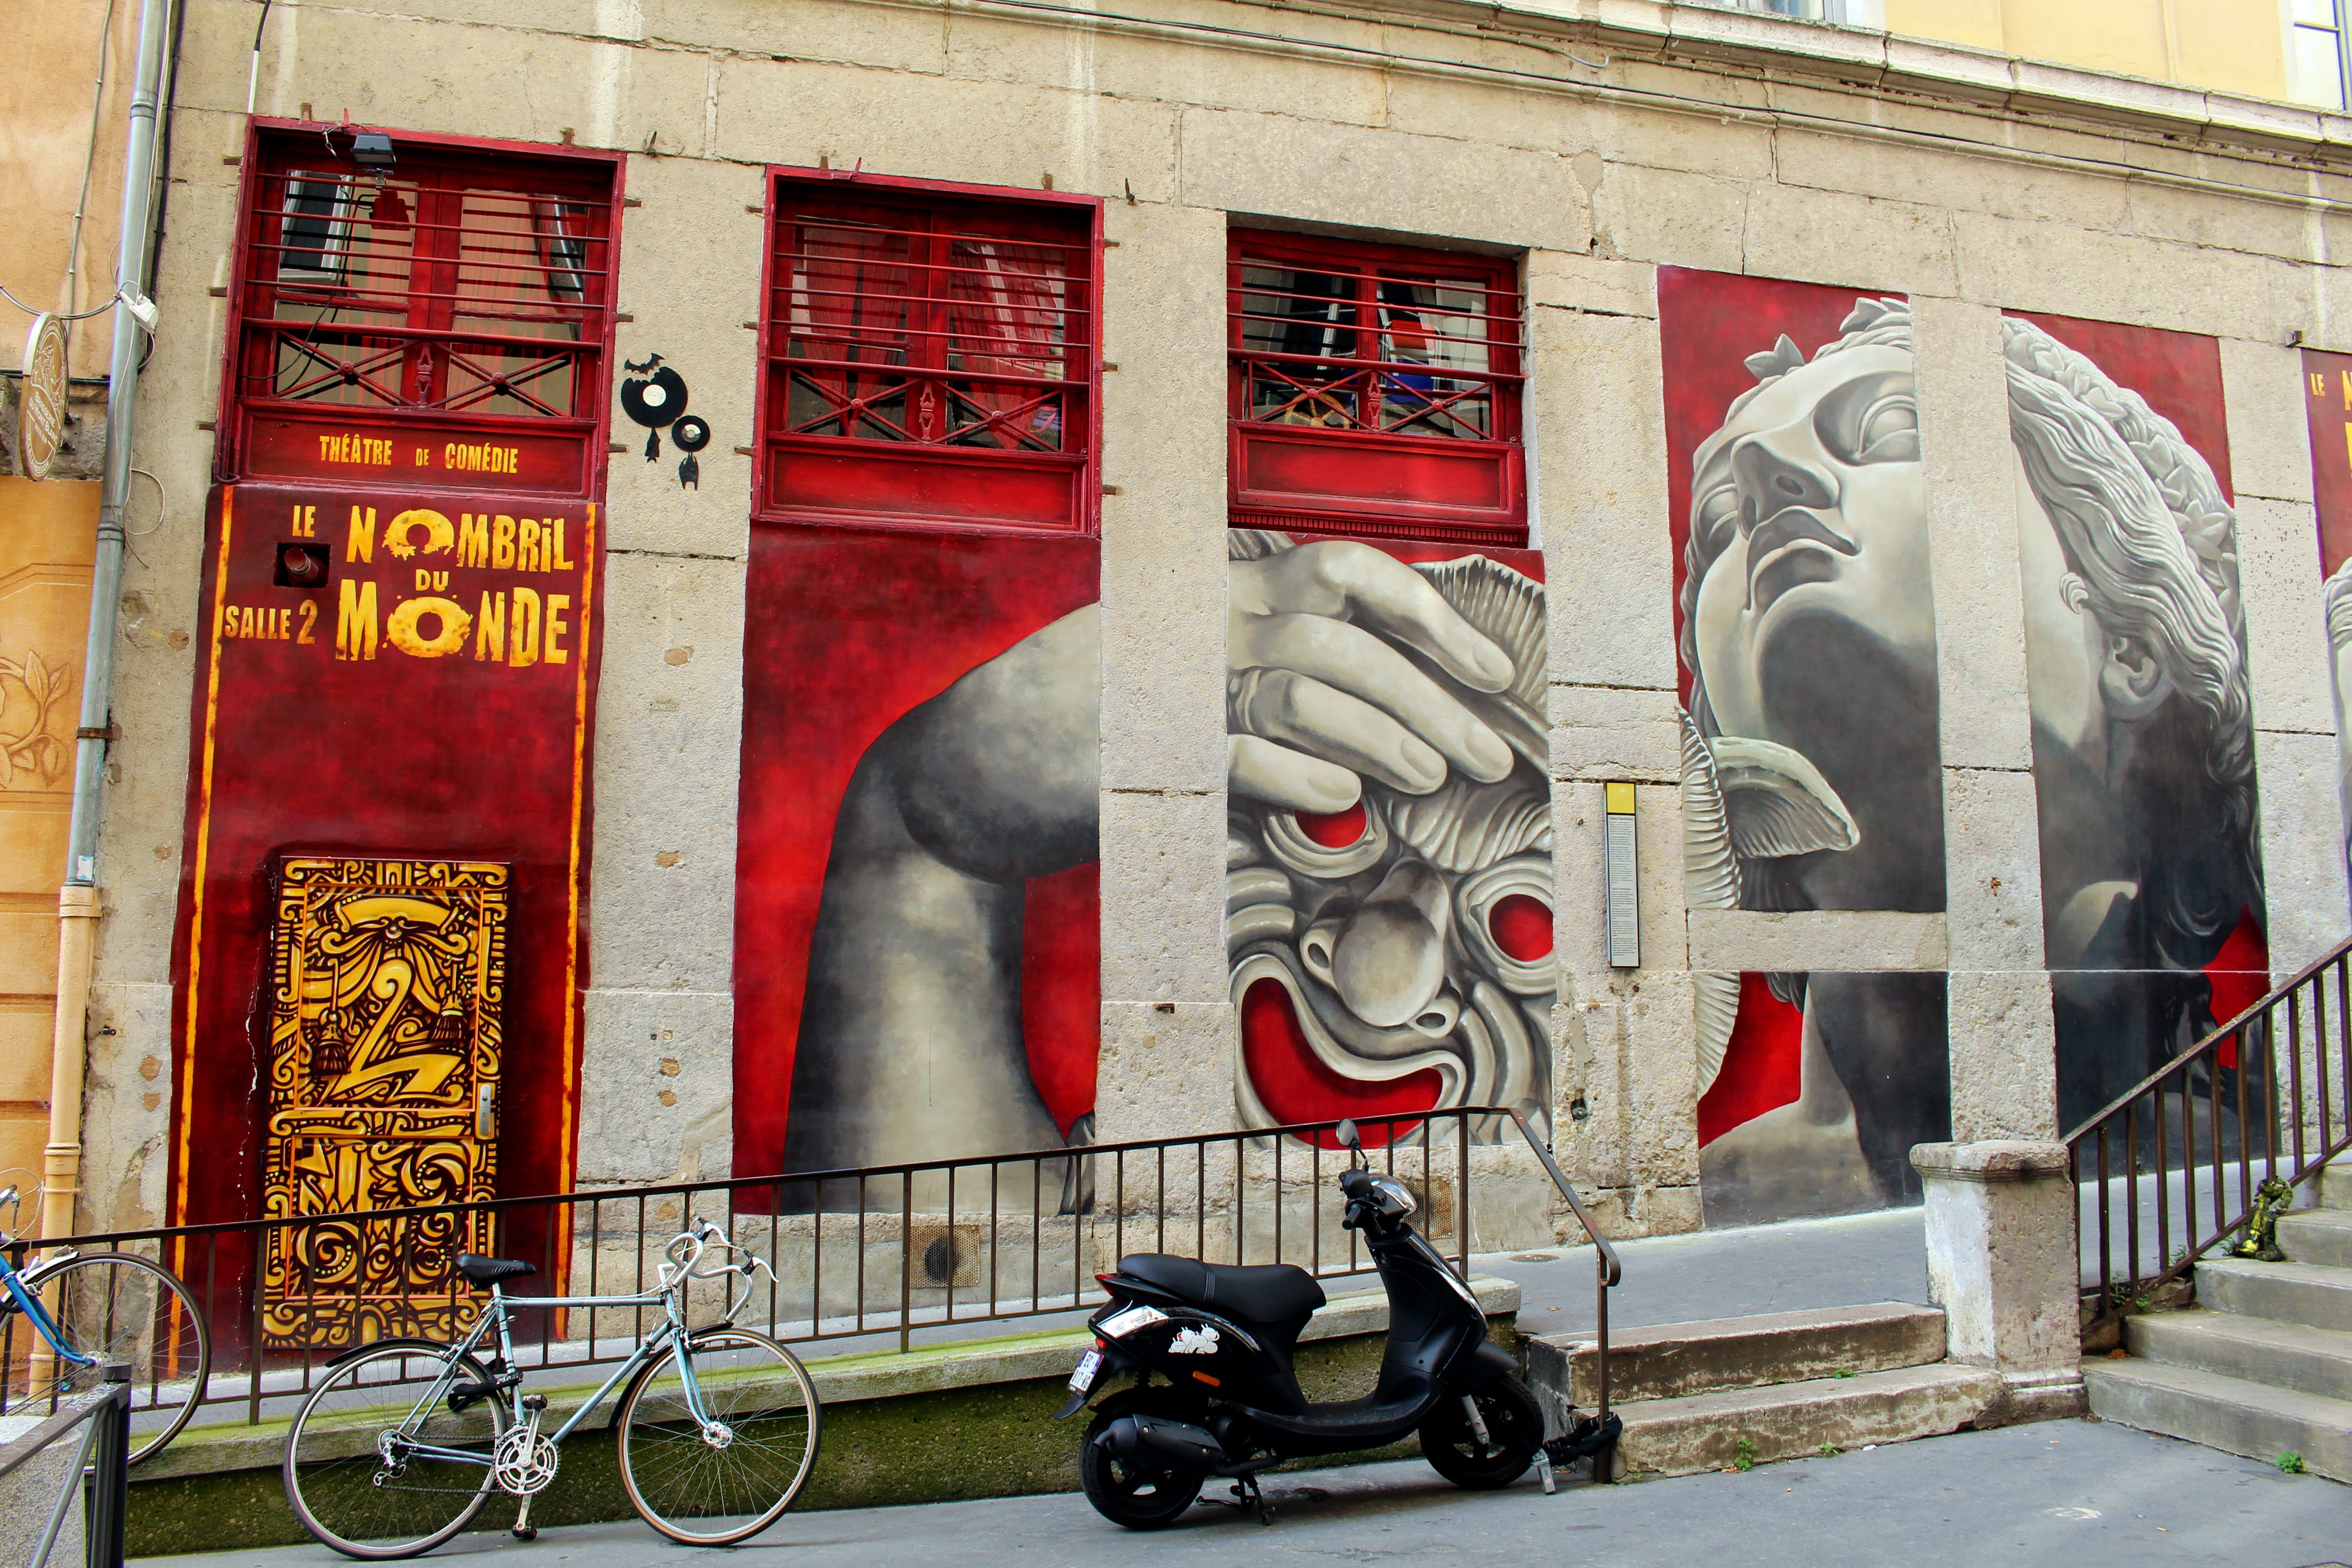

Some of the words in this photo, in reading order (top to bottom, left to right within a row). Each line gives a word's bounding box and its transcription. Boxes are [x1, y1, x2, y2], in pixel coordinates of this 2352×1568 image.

[2310, 373, 2325, 396] LE
[29, 397, 35, 411] DU
[35, 390, 56, 428] BRASSERIE
[319, 434, 393, 465] THÉÂTRE
[416, 448, 429, 466] DE
[446, 442, 518, 474] COMÉDIE
[293, 505, 316, 537] LE
[416, 568, 449, 592] DU
[225, 605, 291, 640] SALLE
[296, 599, 318, 645] 2
[336, 579, 570, 667] MONDE
